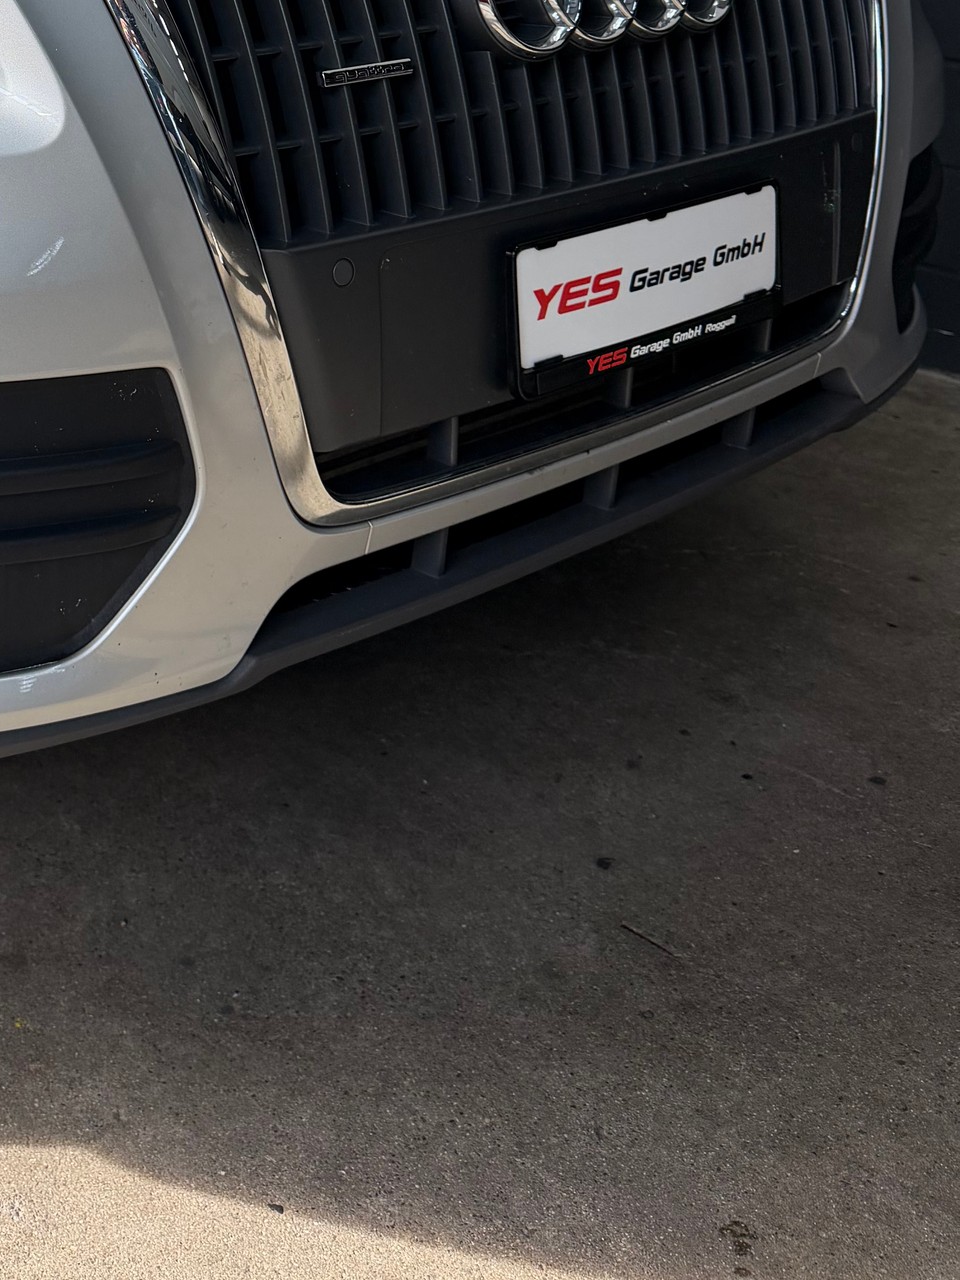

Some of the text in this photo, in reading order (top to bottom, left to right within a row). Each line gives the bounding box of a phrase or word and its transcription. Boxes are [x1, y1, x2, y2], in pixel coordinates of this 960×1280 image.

[533, 232, 766, 321] YES Garage GmbH
[587, 347, 628, 375] YES
[630, 338, 671, 359] Garage
[673, 324, 702, 344] GmbH
